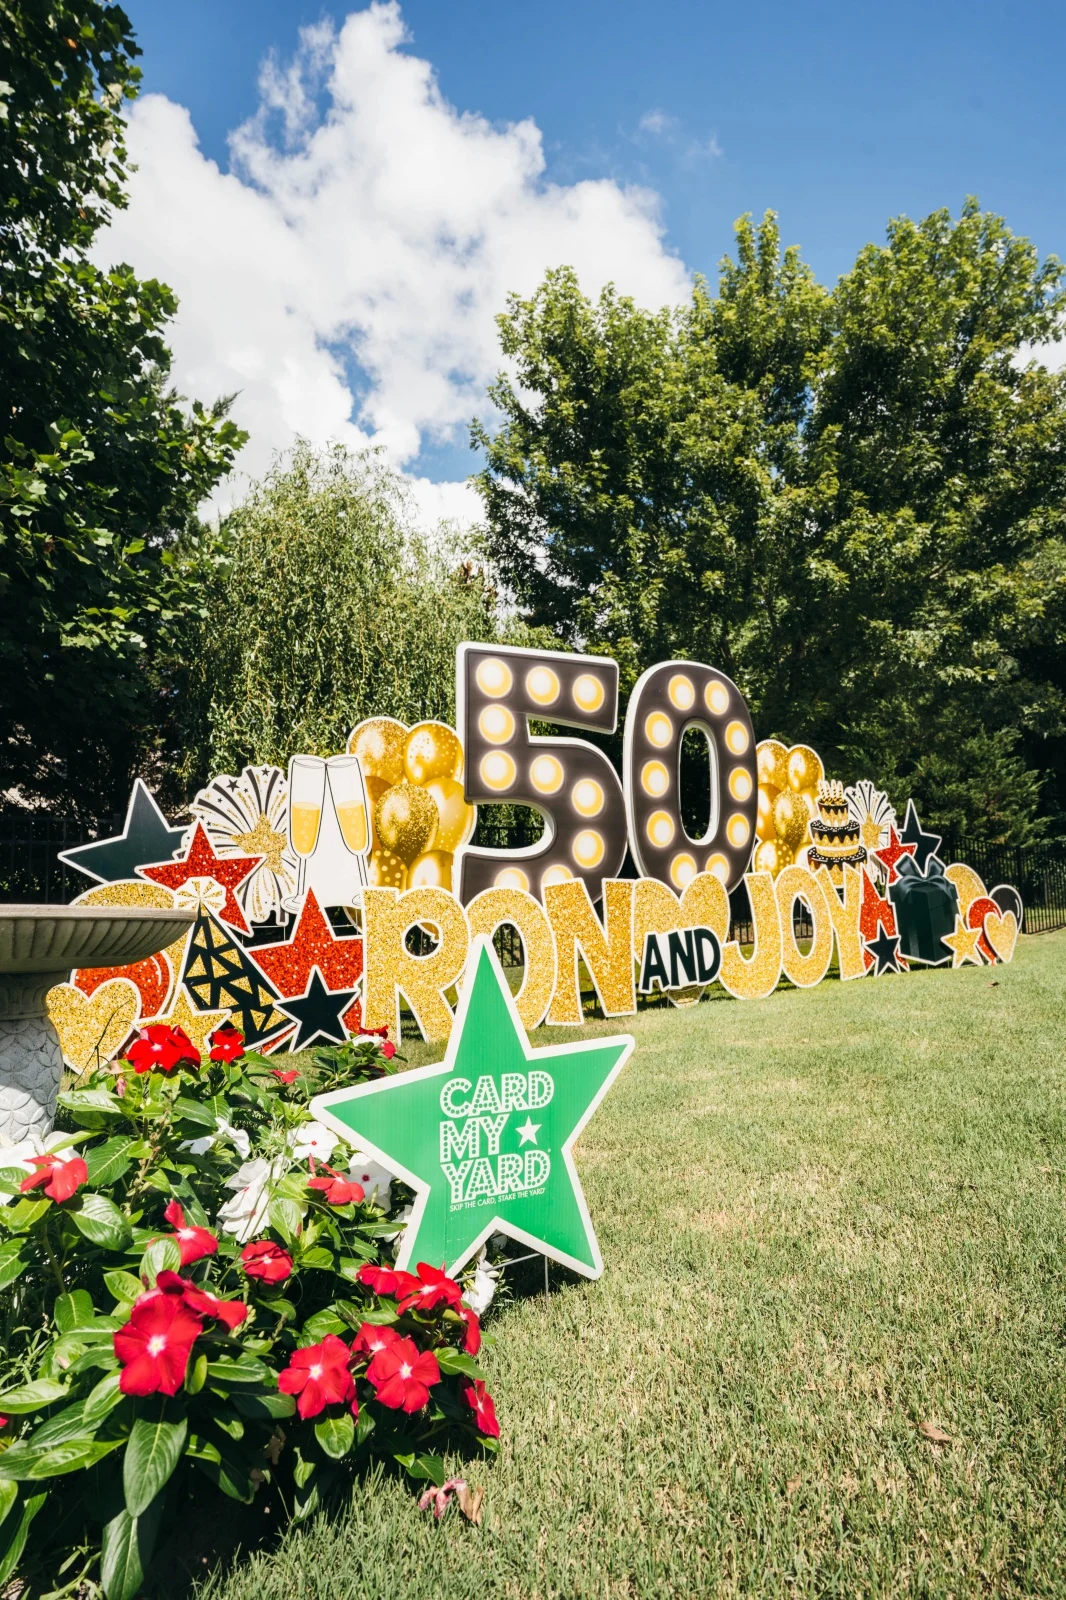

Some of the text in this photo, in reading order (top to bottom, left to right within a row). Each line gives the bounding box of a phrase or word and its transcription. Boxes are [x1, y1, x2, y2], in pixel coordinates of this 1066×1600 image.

[456, 641, 757, 904] 50
[361, 863, 868, 1045] RON AND JOY
[439, 1070, 555, 1119] CARD
[439, 1113, 511, 1163] MY
[440, 1149, 551, 1204] YARD
[449, 1187, 546, 1212] SKIP THE CARD, STAKE THE YARD
